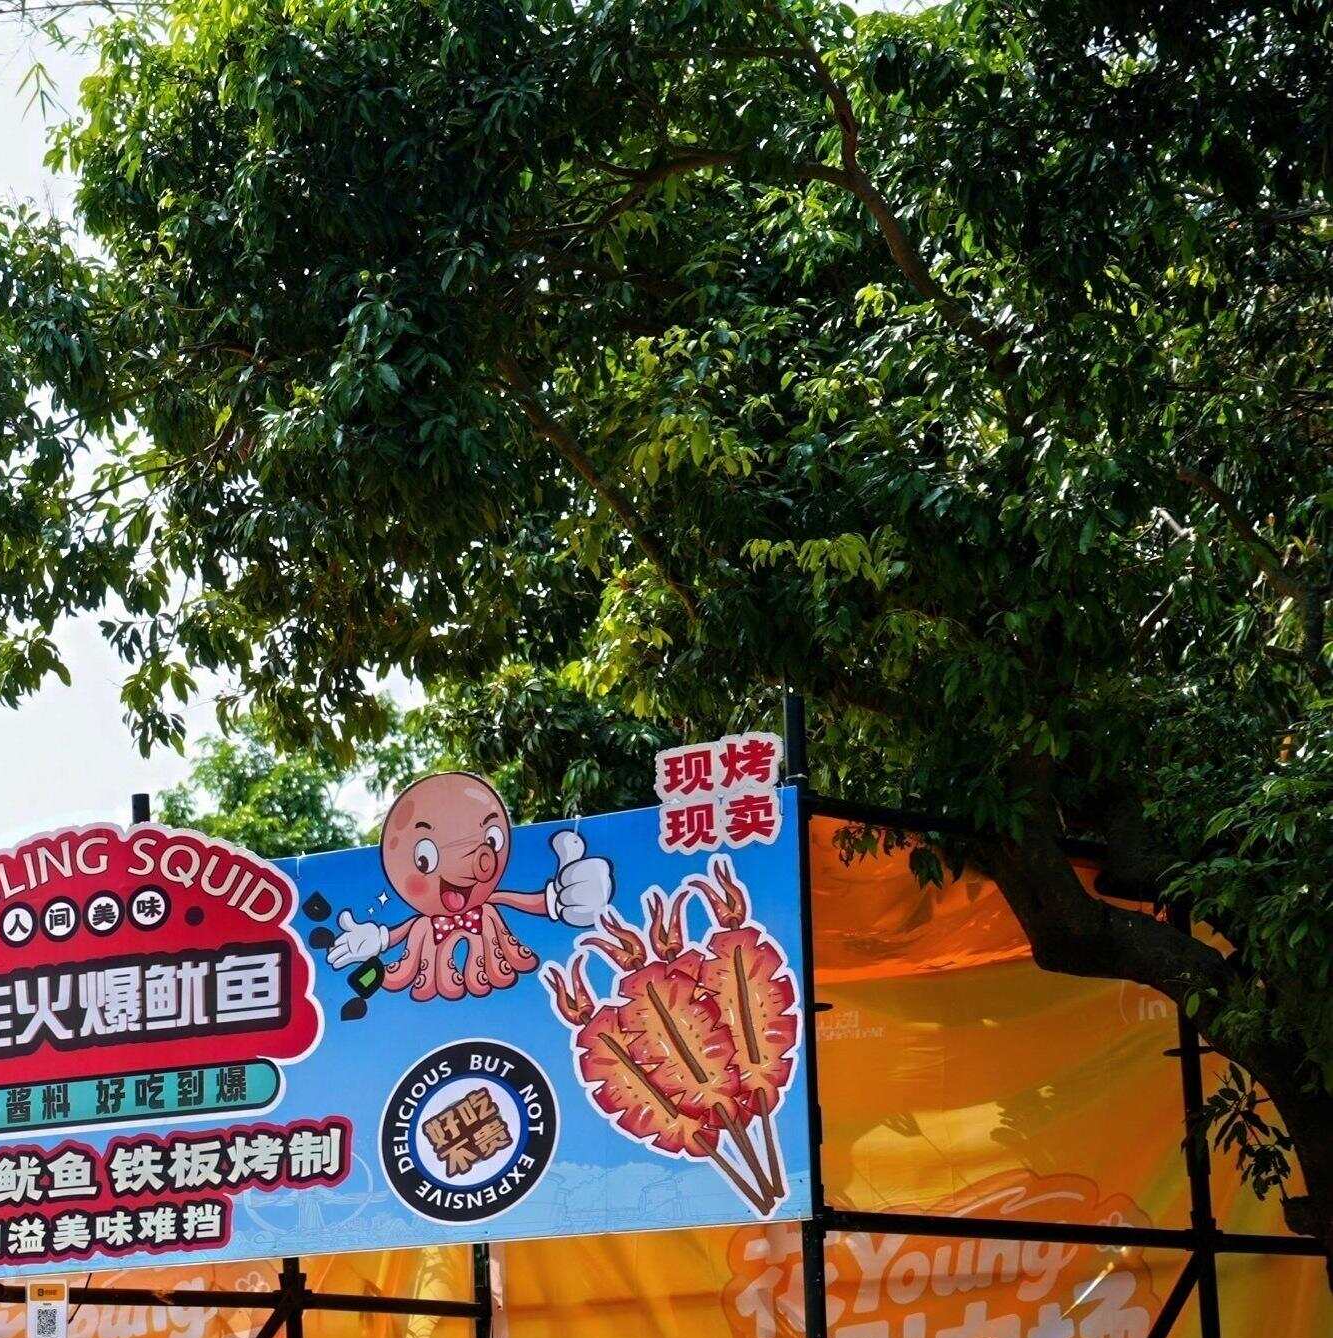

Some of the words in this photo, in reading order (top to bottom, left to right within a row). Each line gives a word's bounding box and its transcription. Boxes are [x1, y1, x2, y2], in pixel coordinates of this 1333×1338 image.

[663, 738, 775, 795] 现烤
[665, 794, 775, 849] 现卖
[127, 836, 285, 924] SQUID
[3, 891, 167, 939] 人间美味
[95, 1064, 247, 1115] 好吃到爆
[469, 1053, 515, 1078] BUT
[393, 1060, 453, 1175] DELICIOUS
[425, 1088, 496, 1150] 好吃
[519, 1083, 545, 1136] NOT
[109, 1127, 342, 1194] 铁板烤制
[439, 1116, 513, 1175] 不贵
[414, 1153, 535, 1210] EXPENSIVE
